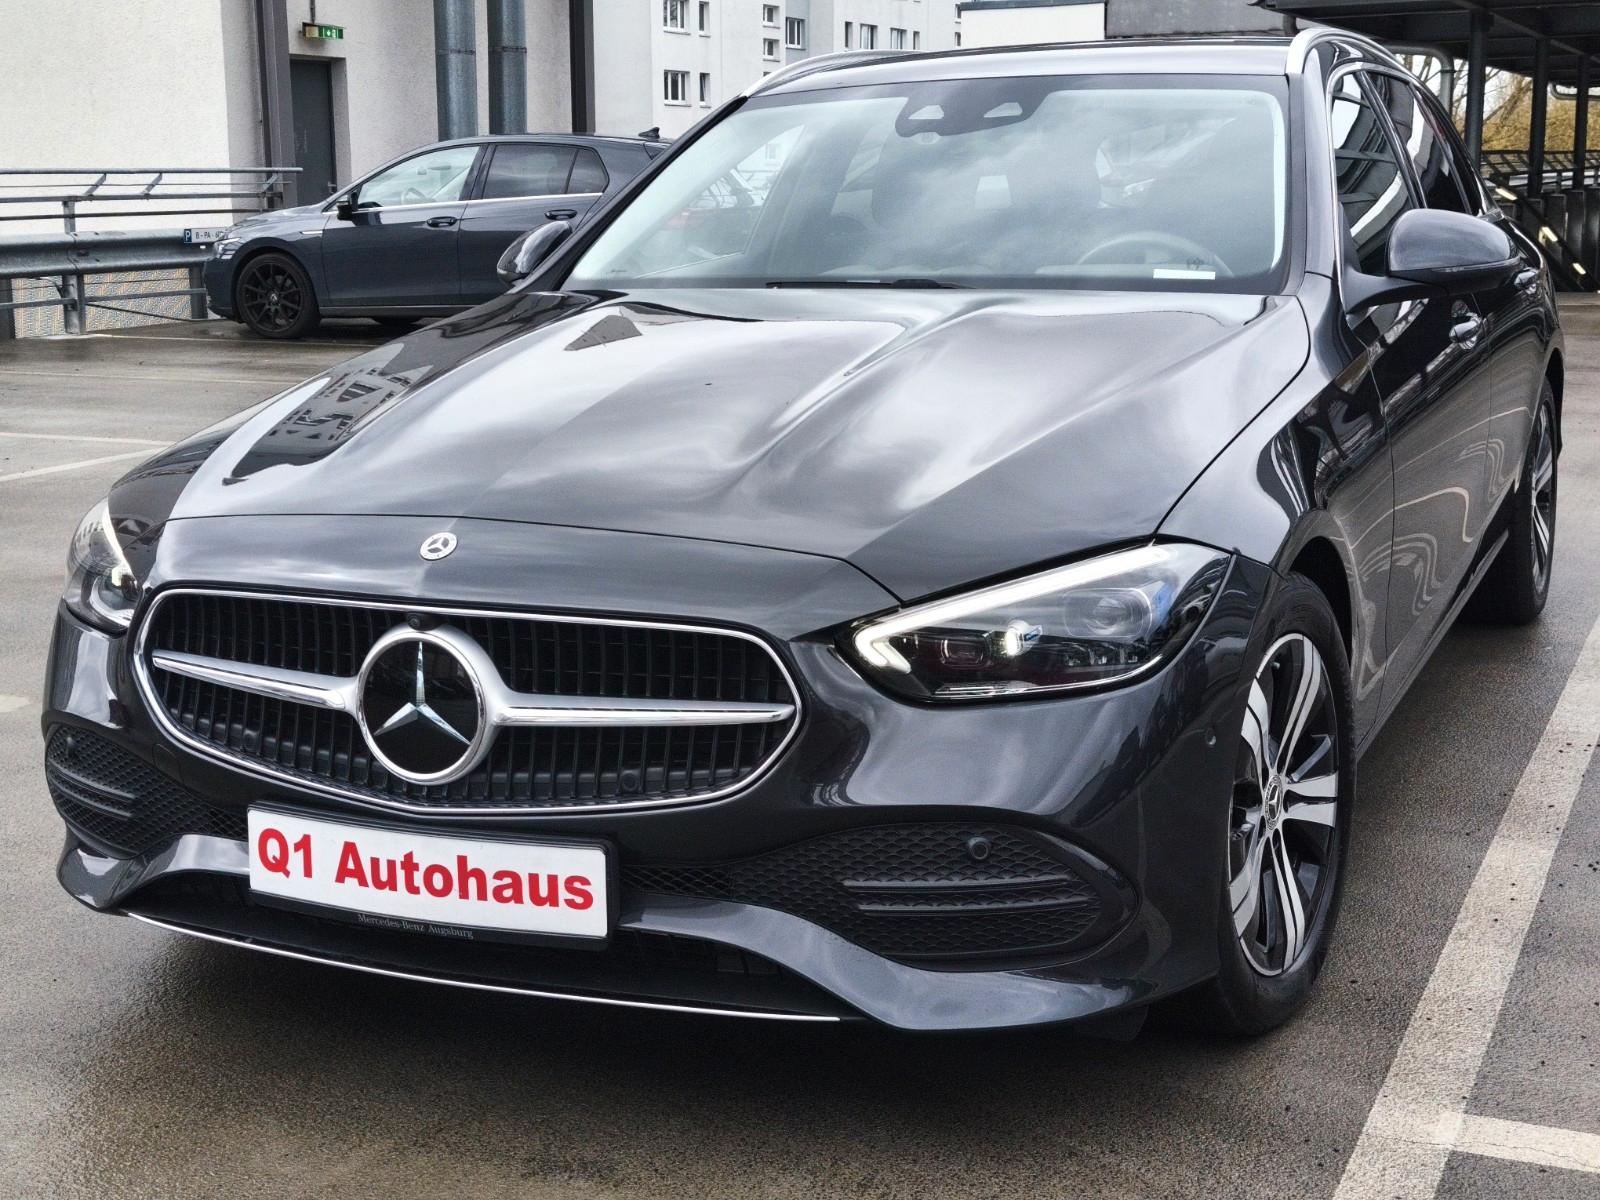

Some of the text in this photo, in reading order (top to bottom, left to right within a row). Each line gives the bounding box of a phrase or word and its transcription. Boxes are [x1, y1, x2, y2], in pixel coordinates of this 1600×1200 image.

[257, 828, 594, 911] Q1 Autohaus
[428, 925, 474, 940] Augsburg
